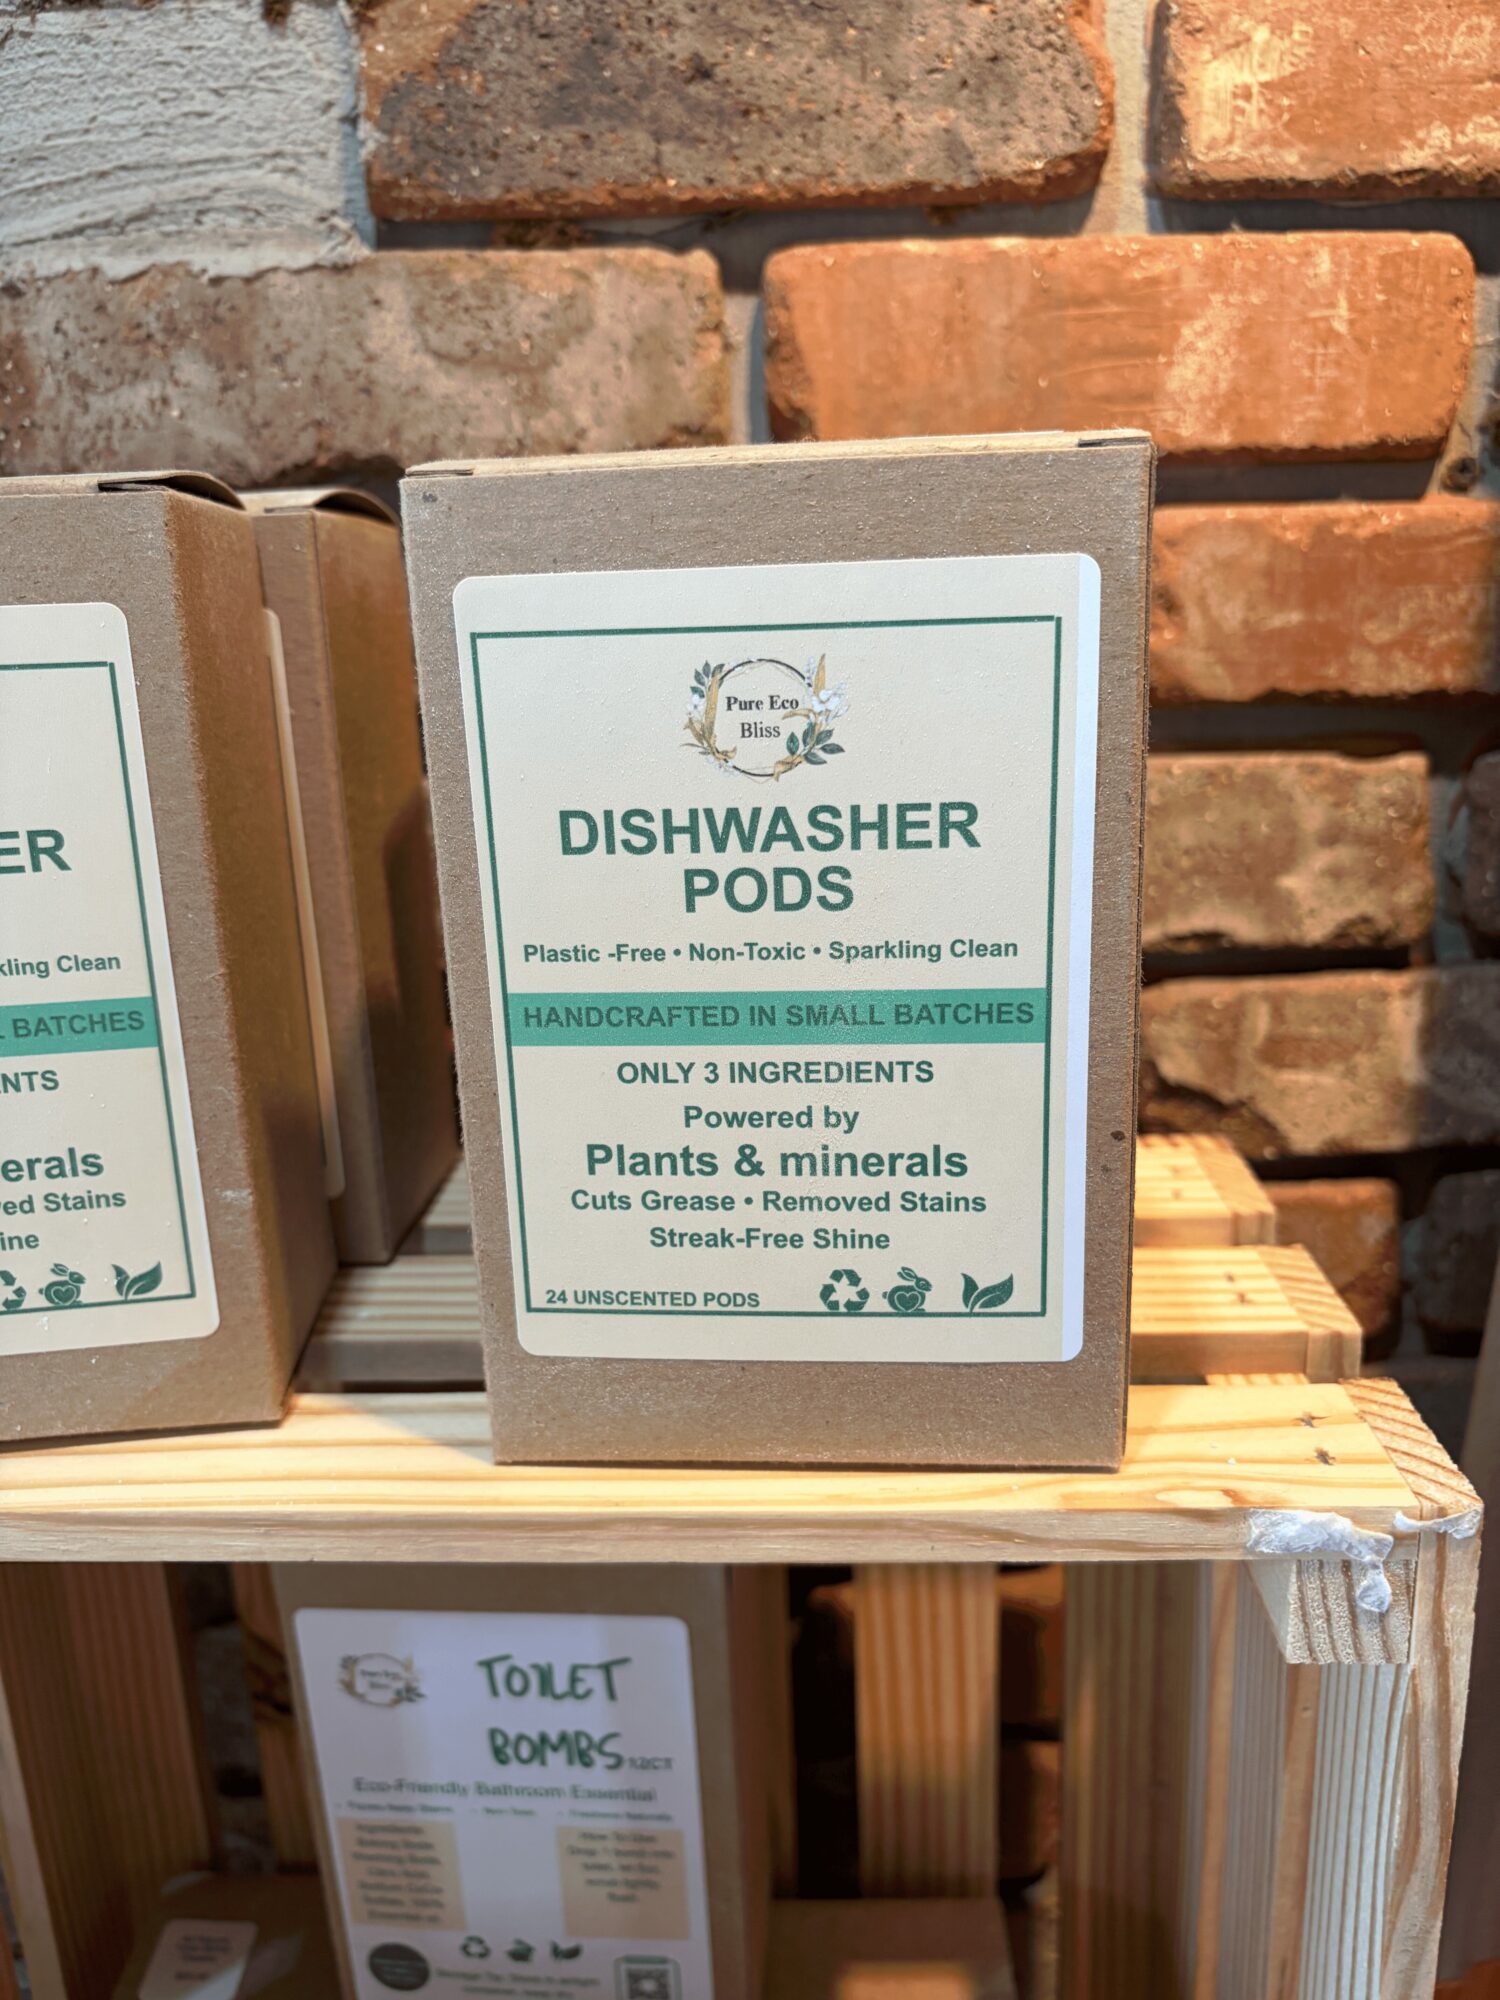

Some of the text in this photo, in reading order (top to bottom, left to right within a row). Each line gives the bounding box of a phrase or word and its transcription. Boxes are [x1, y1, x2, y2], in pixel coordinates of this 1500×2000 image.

[725, 694, 800, 712] Pure Eco
[740, 721, 781, 739] Bliss
[558, 801, 982, 856] DISHWASHER
[683, 865, 854, 914] PODS
[56, 954, 121, 973] Clean
[523, 938, 1018, 965] Plastic -Free Non-Toxic Sparkling Clean
[11, 1010, 145, 1039] BATCHES
[523, 1002, 1034, 1029] HANDCRAFTED IN SMALL BATCHES
[0, 1069, 60, 1094] NTS
[616, 1060, 934, 1085] ONLY 3 INGREDIENTS
[683, 1104, 860, 1135] Powered by
[0, 1147, 104, 1183] erals
[586, 1143, 968, 1178] Plants & minerals
[0, 1189, 127, 1216] ed Stains
[570, 1189, 987, 1213] Cuts Grease Removed Stains
[649, 1226, 890, 1250] Streak-Free Shine
[545, 1289, 761, 1308] 24 UNSCENTED PODS
[477, 1654, 633, 1703] TOILET
[488, 1727, 624, 1770] BOMBS
